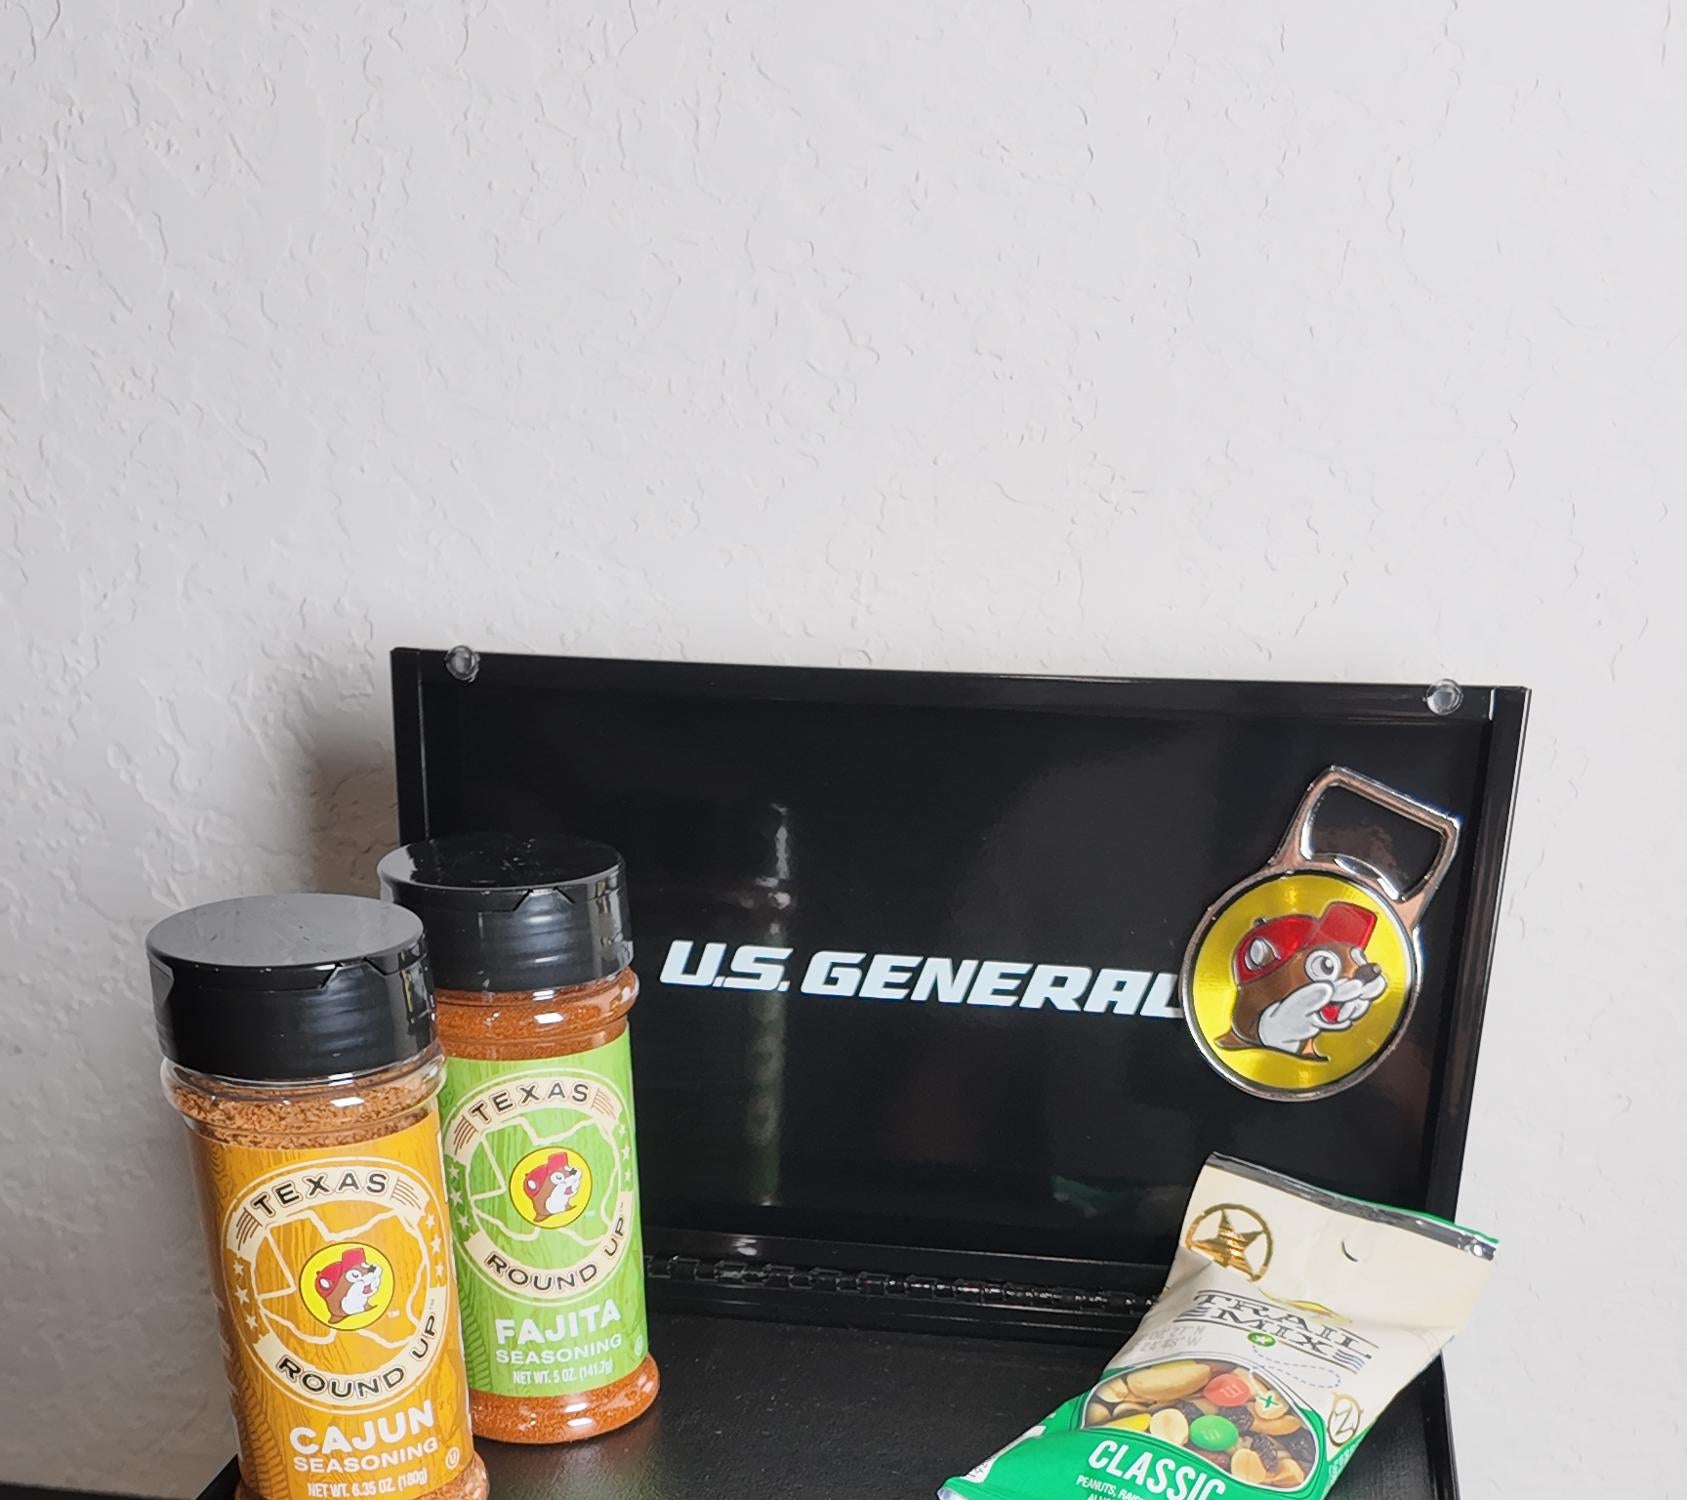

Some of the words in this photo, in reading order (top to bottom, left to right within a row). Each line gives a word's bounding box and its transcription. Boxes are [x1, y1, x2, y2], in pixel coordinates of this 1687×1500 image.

[659, 940, 790, 992] U.S.
[800, 951, 1185, 1019] GENERAL
[471, 1083, 589, 1122] TEXAS
[253, 1173, 387, 1215] TEXAS
[486, 1253, 597, 1291] ROUND
[604, 1217, 624, 1257] UP
[495, 1299, 621, 1345] FAJITA
[1194, 1294, 1366, 1354] TRAIL
[1210, 1308, 1332, 1355] MIX
[278, 1357, 404, 1397] ROUND
[411, 1315, 435, 1359] UP
[496, 1334, 622, 1364] SEASONING
[513, 1370, 532, 1384] NET
[553, 1368, 561, 1382] 5
[289, 1399, 434, 1454] CAJUN
[293, 1436, 438, 1473] SEASONING
[307, 1483, 328, 1498] NET
[330, 1482, 350, 1498] WT.
[352, 1479, 376, 1496] 6.35
[398, 1467, 428, 1491] (180g)
[1076, 1475, 1117, 1497] PEANUTS,
